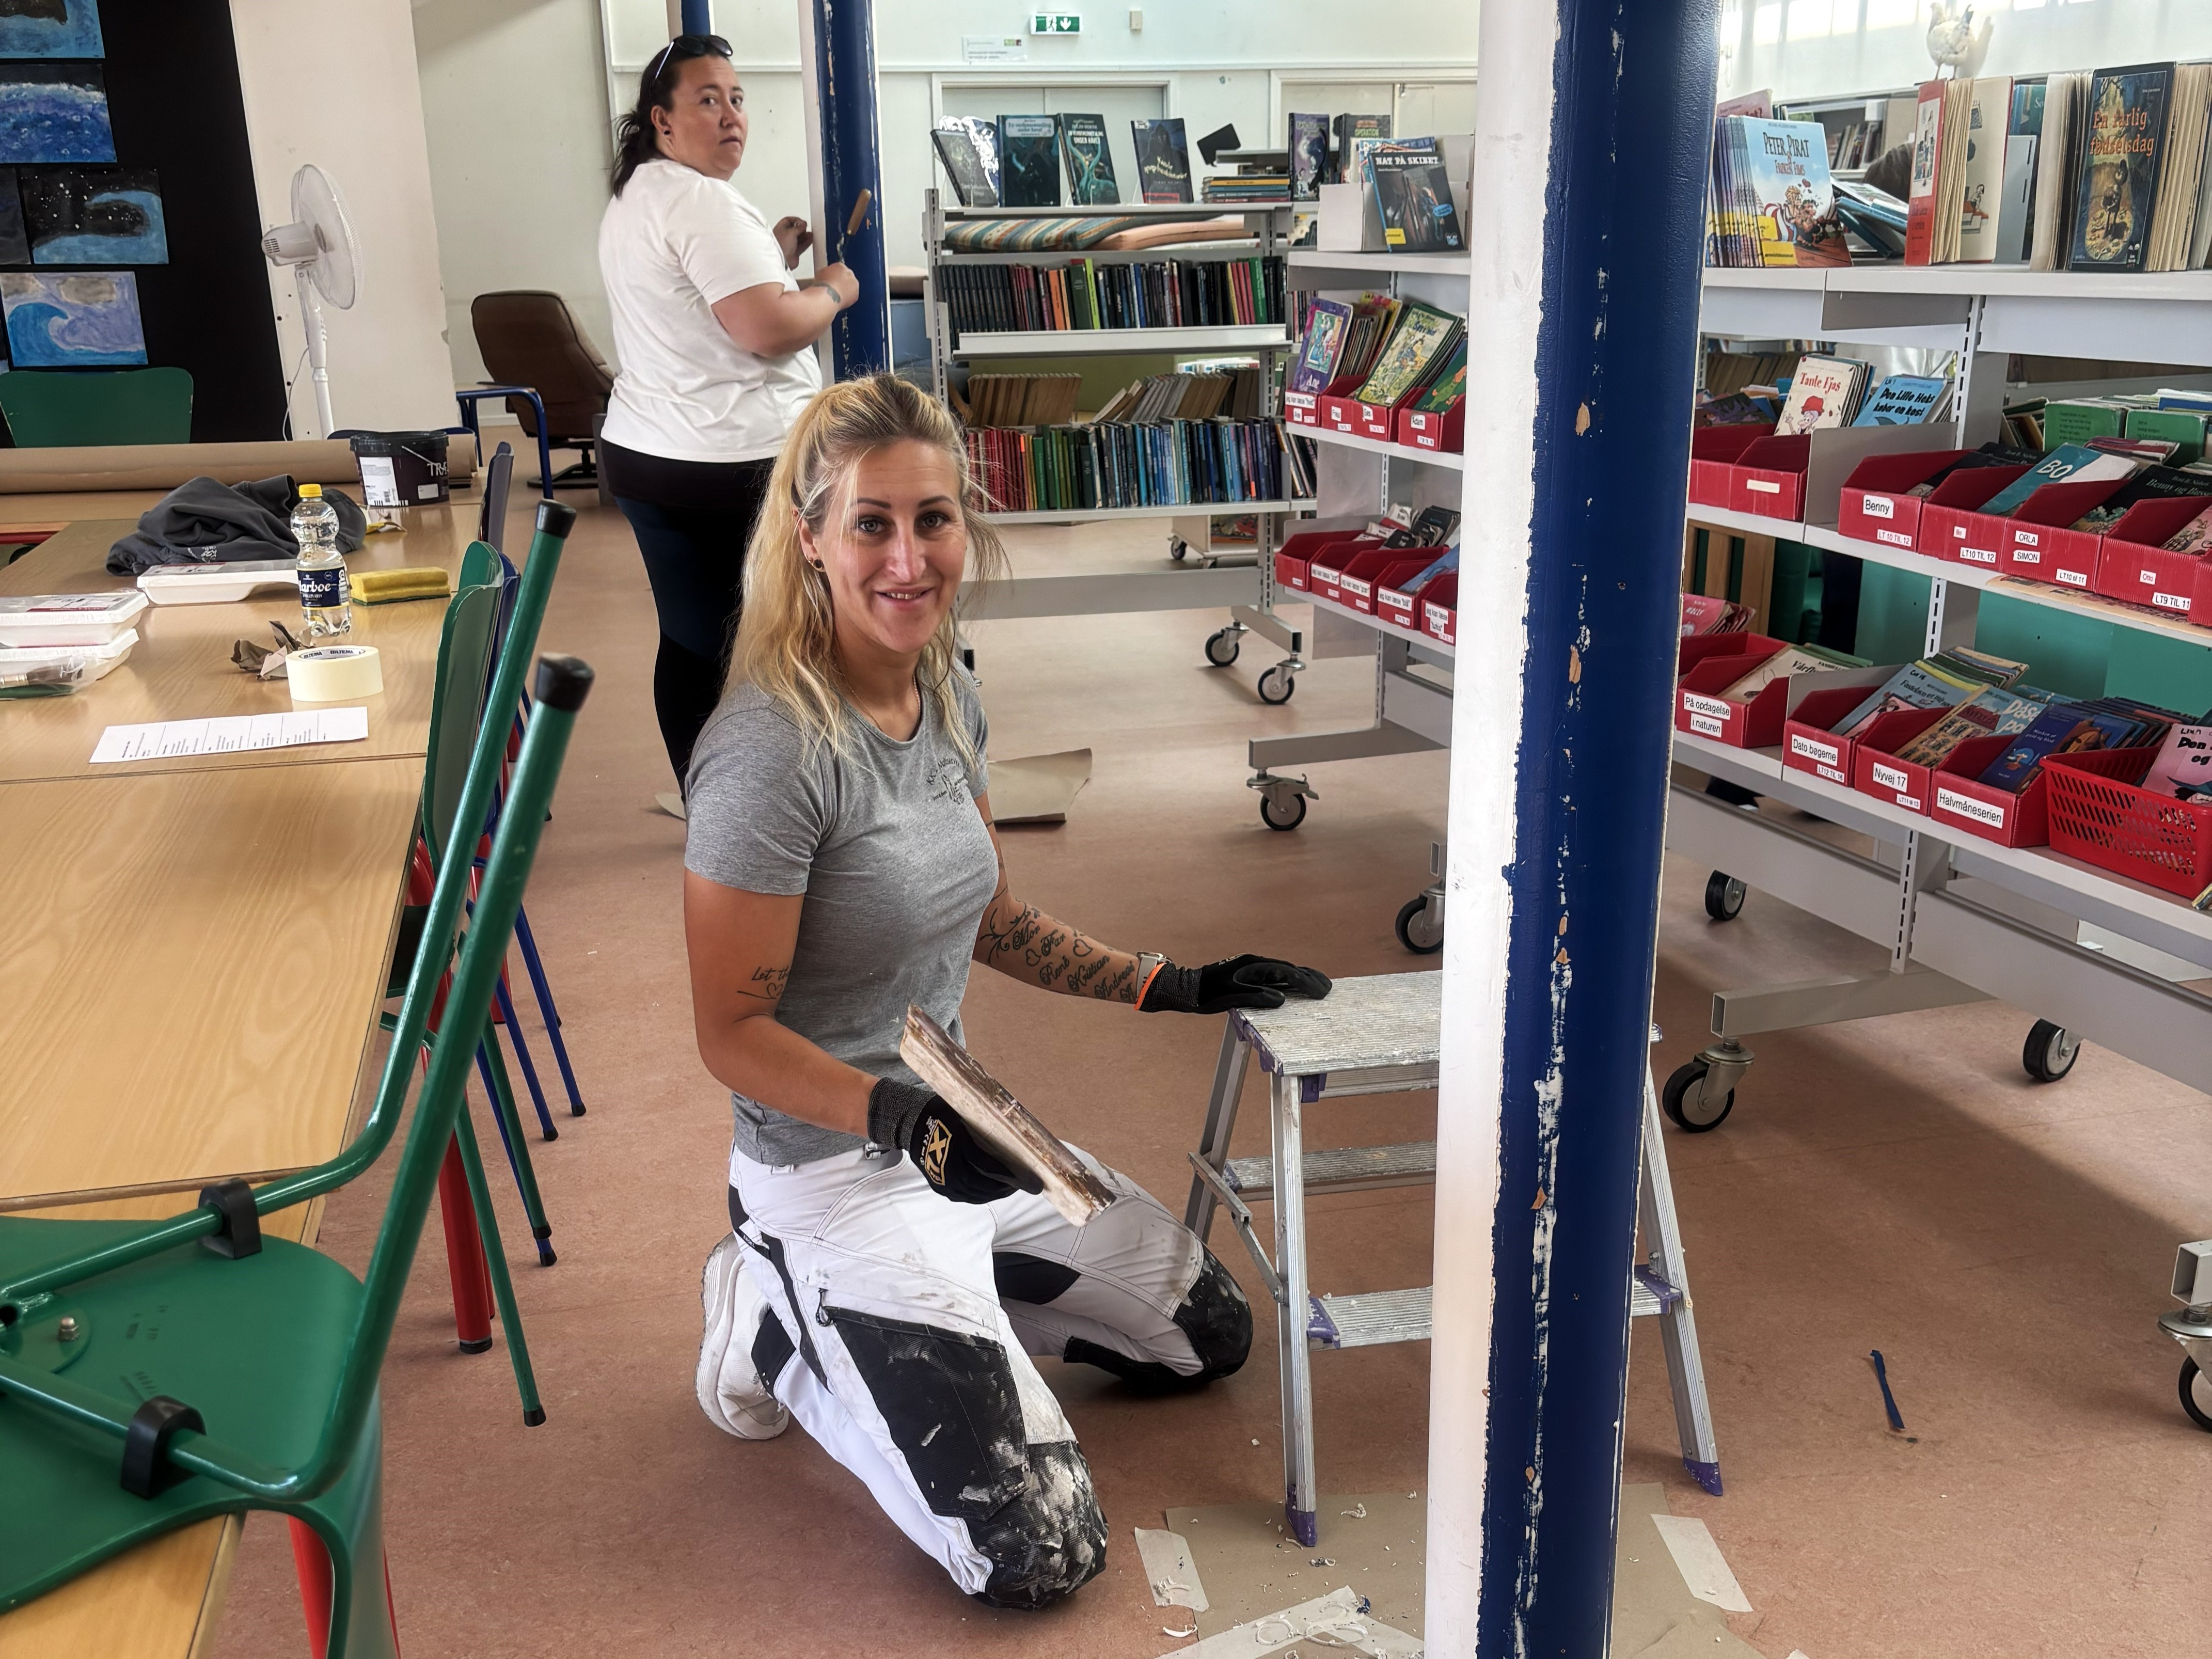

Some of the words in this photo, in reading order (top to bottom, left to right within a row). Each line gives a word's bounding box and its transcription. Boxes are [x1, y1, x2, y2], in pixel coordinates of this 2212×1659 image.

[2093, 111, 2108, 129] En
[2112, 107, 2147, 130] farlig
[1763, 132, 1785, 155] PETER
[1787, 134, 1810, 158] PIRAT
[1800, 372, 1822, 388] Tante
[1823, 376, 1841, 394] Fjas
[2036, 459, 2074, 479] BO
[1865, 499, 1890, 515] Benny
[1894, 534, 1902, 543] TIL
[2018, 533, 2036, 544] ORLA
[1962, 549, 1976, 559] LT10
[1977, 551, 1985, 560] TIL
[2017, 551, 2038, 561] SIMON
[2155, 595, 2168, 605] LT9
[2169, 597, 2180, 607] TIL
[2182, 599, 2190, 608] 11
[1685, 697, 1694, 707] På
[1696, 701, 1730, 715] opdagelse
[1695, 720, 1721, 733] naturen
[1793, 738, 1808, 753] Dato
[1809, 744, 1837, 762] bøgerne
[2177, 737, 2207, 750] Den
[2191, 755, 2211, 765] og
[1874, 767, 1895, 785] Nyvej
[1897, 776, 1907, 787] 17
[1939, 793, 2002, 824] Halvmåneserien
[751, 966, 777, 981] Let
[1067, 955, 1110, 992] Kristian
